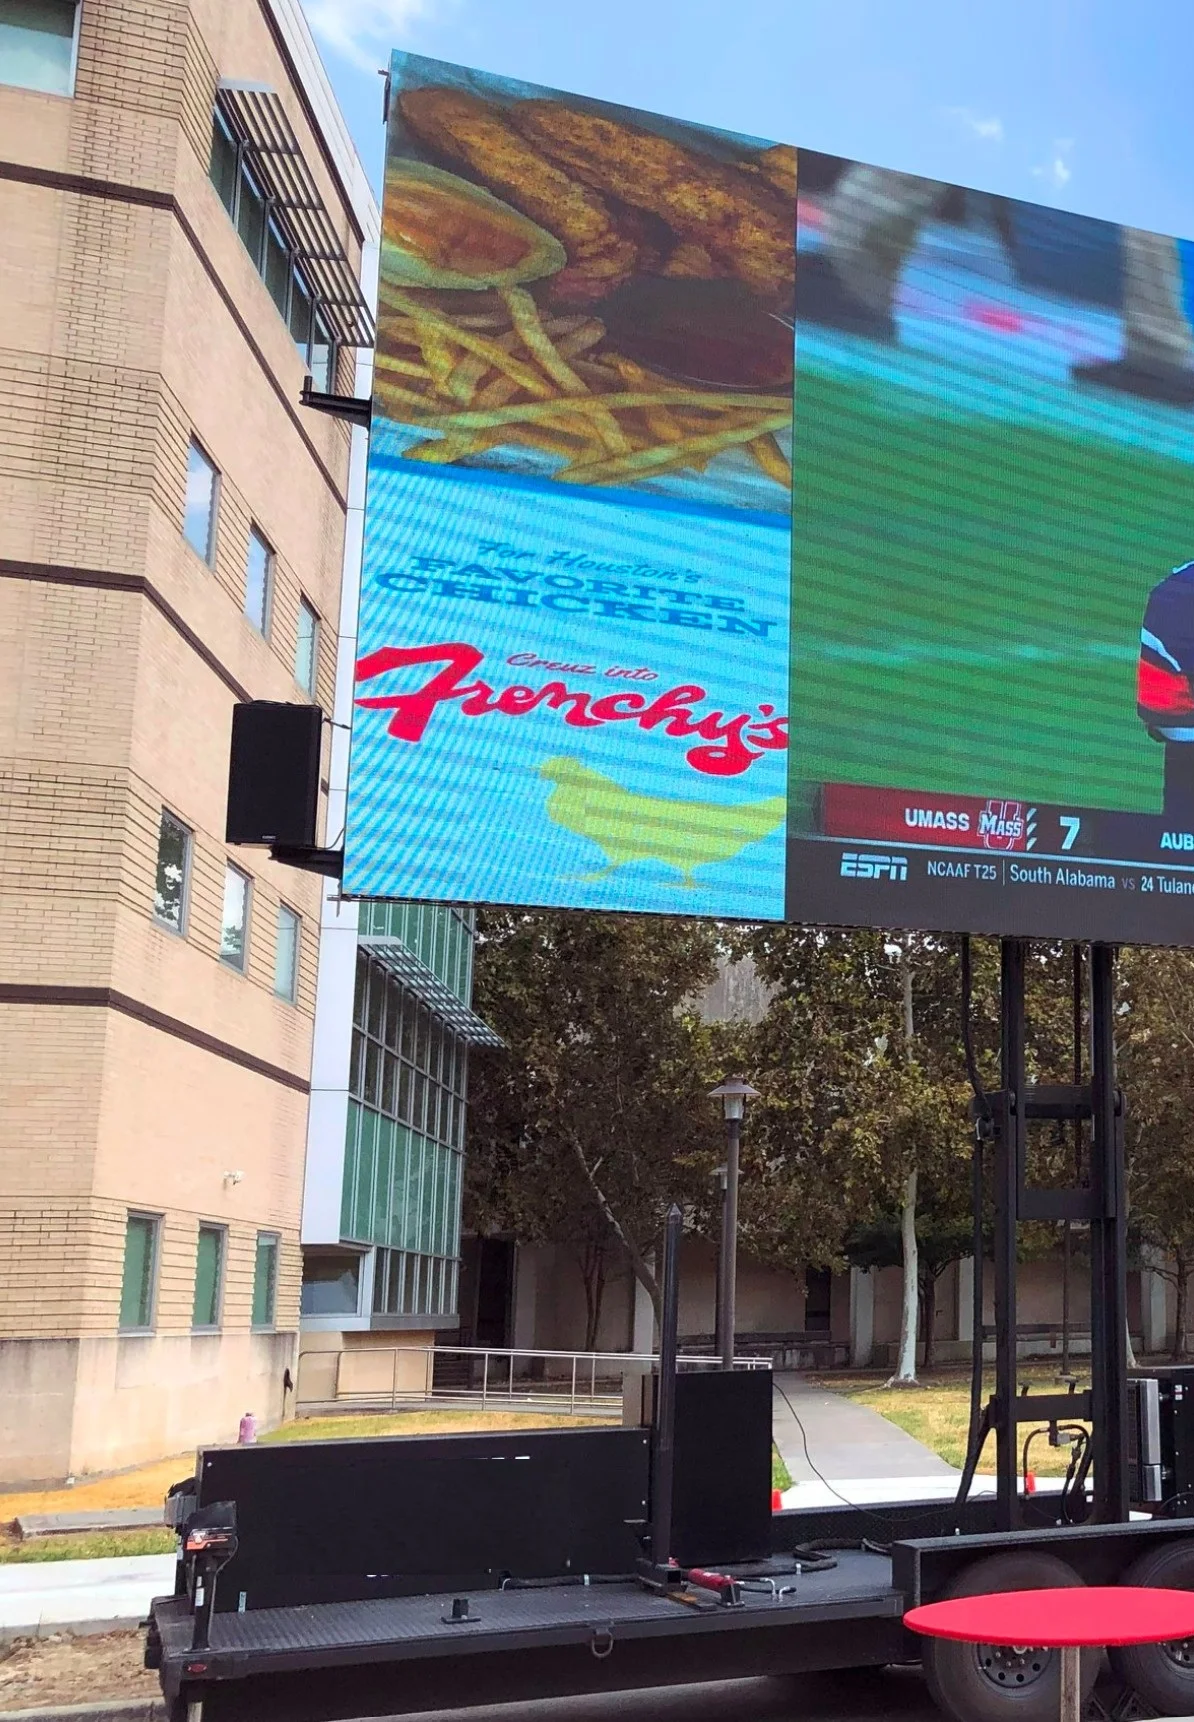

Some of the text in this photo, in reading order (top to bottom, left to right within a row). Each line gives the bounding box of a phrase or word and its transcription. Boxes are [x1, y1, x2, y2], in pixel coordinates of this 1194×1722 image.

[479, 541, 702, 584] For Houston's
[375, 573, 777, 637] CHICKEN
[411, 556, 745, 612] FAVORITE
[507, 653, 658, 681] Creuz into
[354, 642, 790, 776] Frenchy's
[905, 808, 970, 832] UMASS
[1059, 816, 1080, 850] 7
[840, 852, 997, 880] ESPN NCAAF T25
[1010, 863, 1051, 885] South
[1055, 869, 1115, 890] Alabama
[1121, 878, 1135, 890] vs
[1141, 878, 1154, 892] 24
